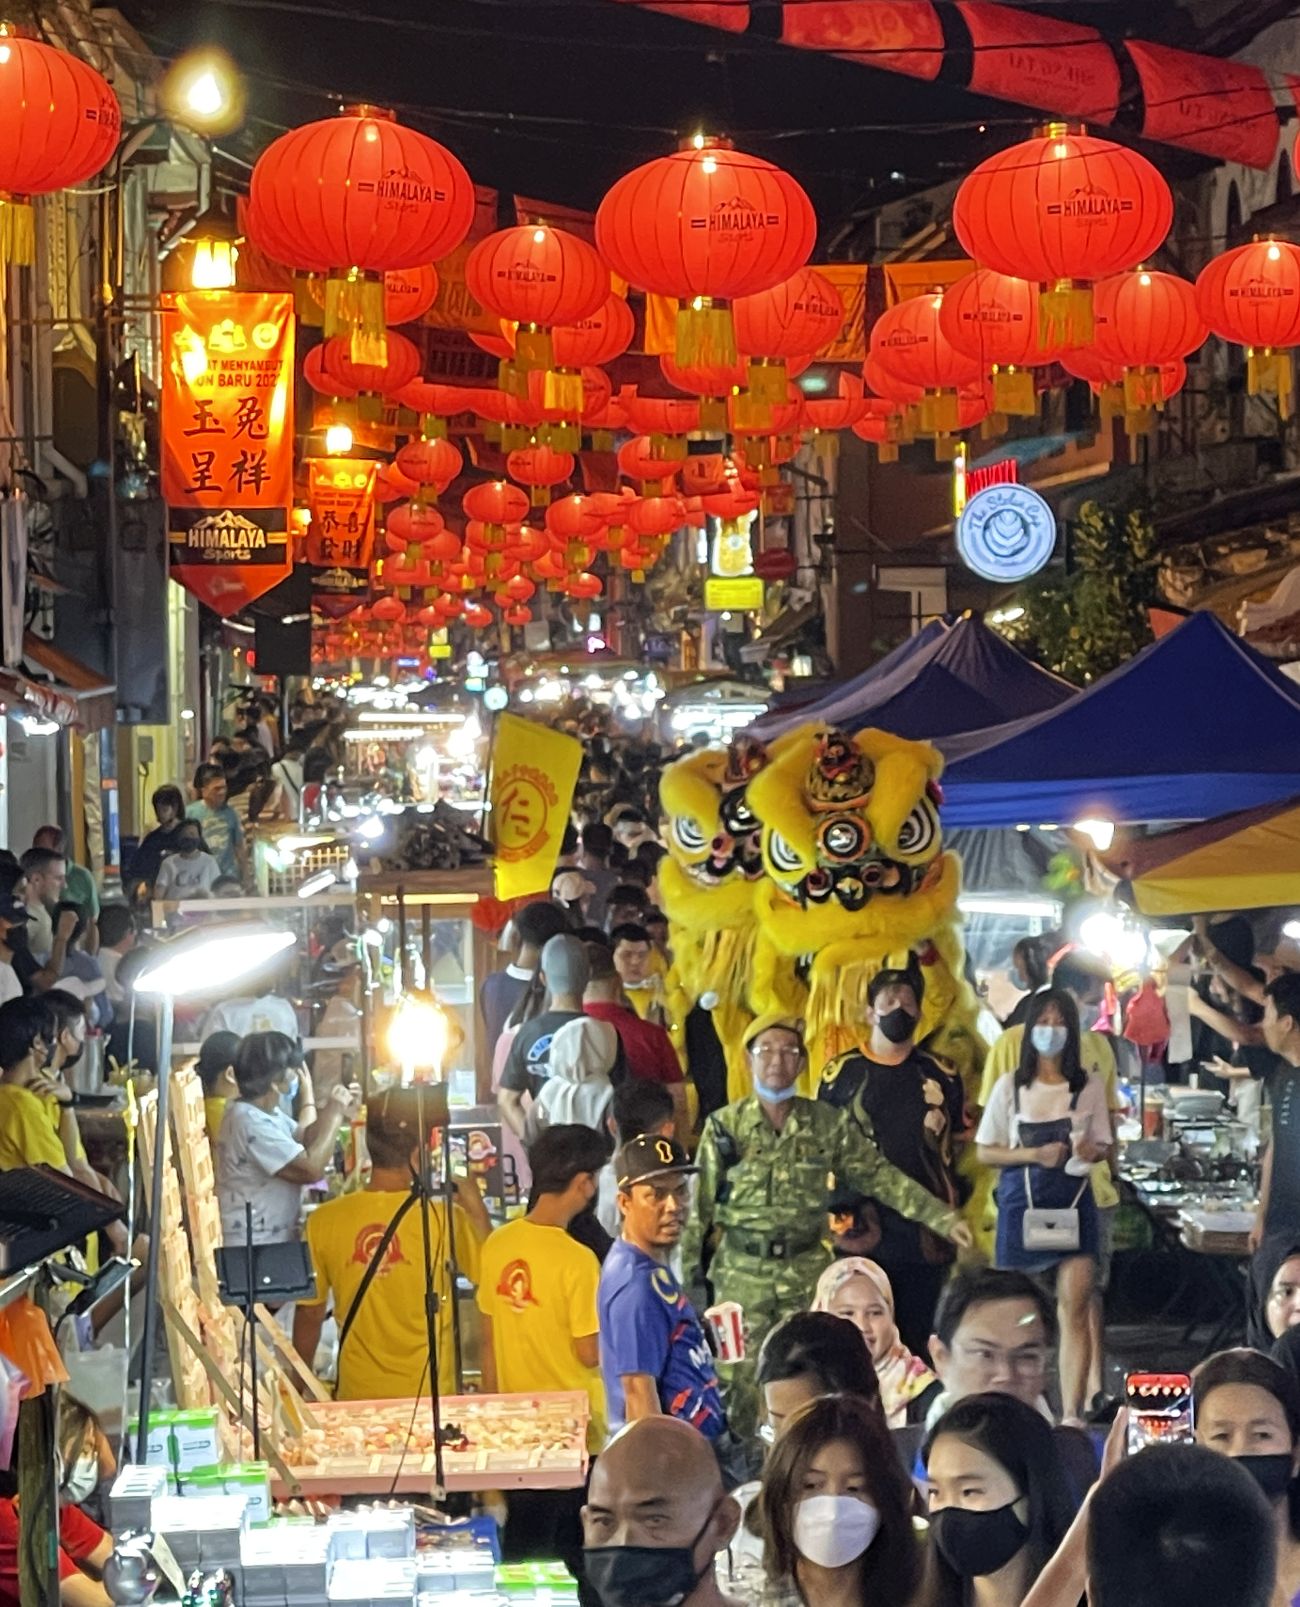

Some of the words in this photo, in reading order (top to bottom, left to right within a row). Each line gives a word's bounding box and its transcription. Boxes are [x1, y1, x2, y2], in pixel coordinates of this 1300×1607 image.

[377, 179, 432, 203] HIMALAYA
[1064, 197, 1120, 217] HIMALAYA
[709, 212, 765, 232] HIMALAYA
[218, 373, 252, 388] BARU
[256, 373, 281, 388] 202
[183, 449, 272, 496] 呈祥
[187, 528, 267, 549] HIMALAYA
[203, 548, 252, 563] Sports
